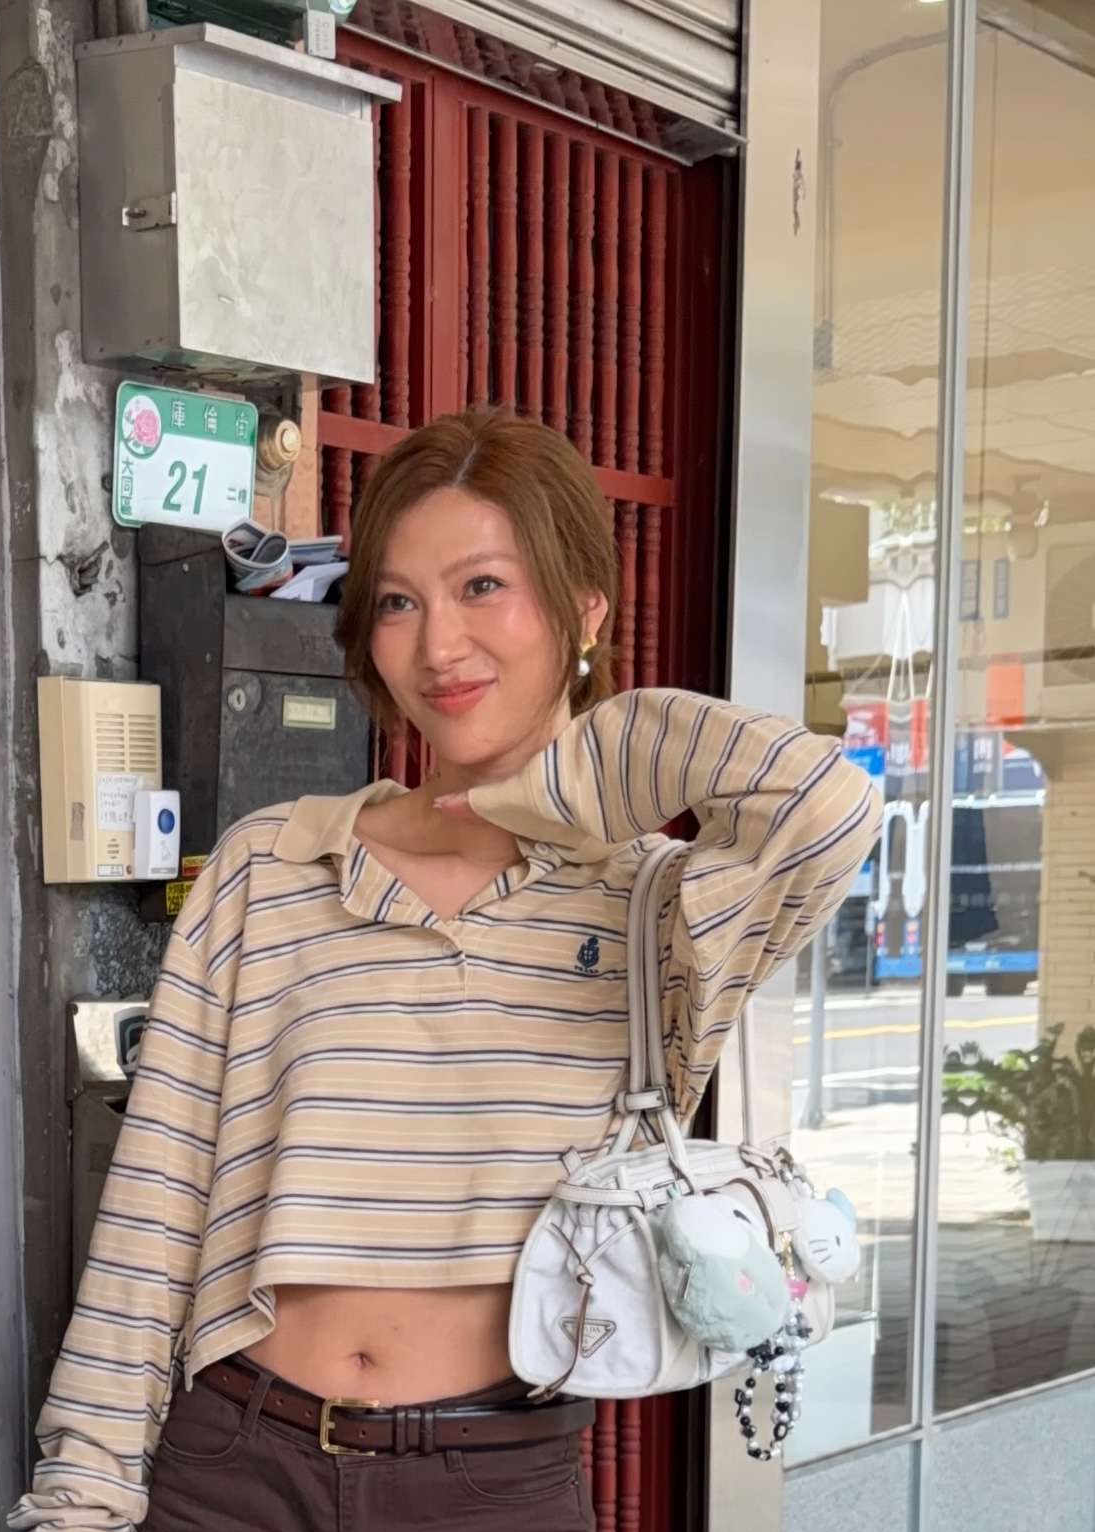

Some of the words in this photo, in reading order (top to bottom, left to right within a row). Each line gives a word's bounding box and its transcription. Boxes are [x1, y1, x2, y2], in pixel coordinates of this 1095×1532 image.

[121, 456, 133, 516] 大同區
[163, 460, 207, 515] 21
